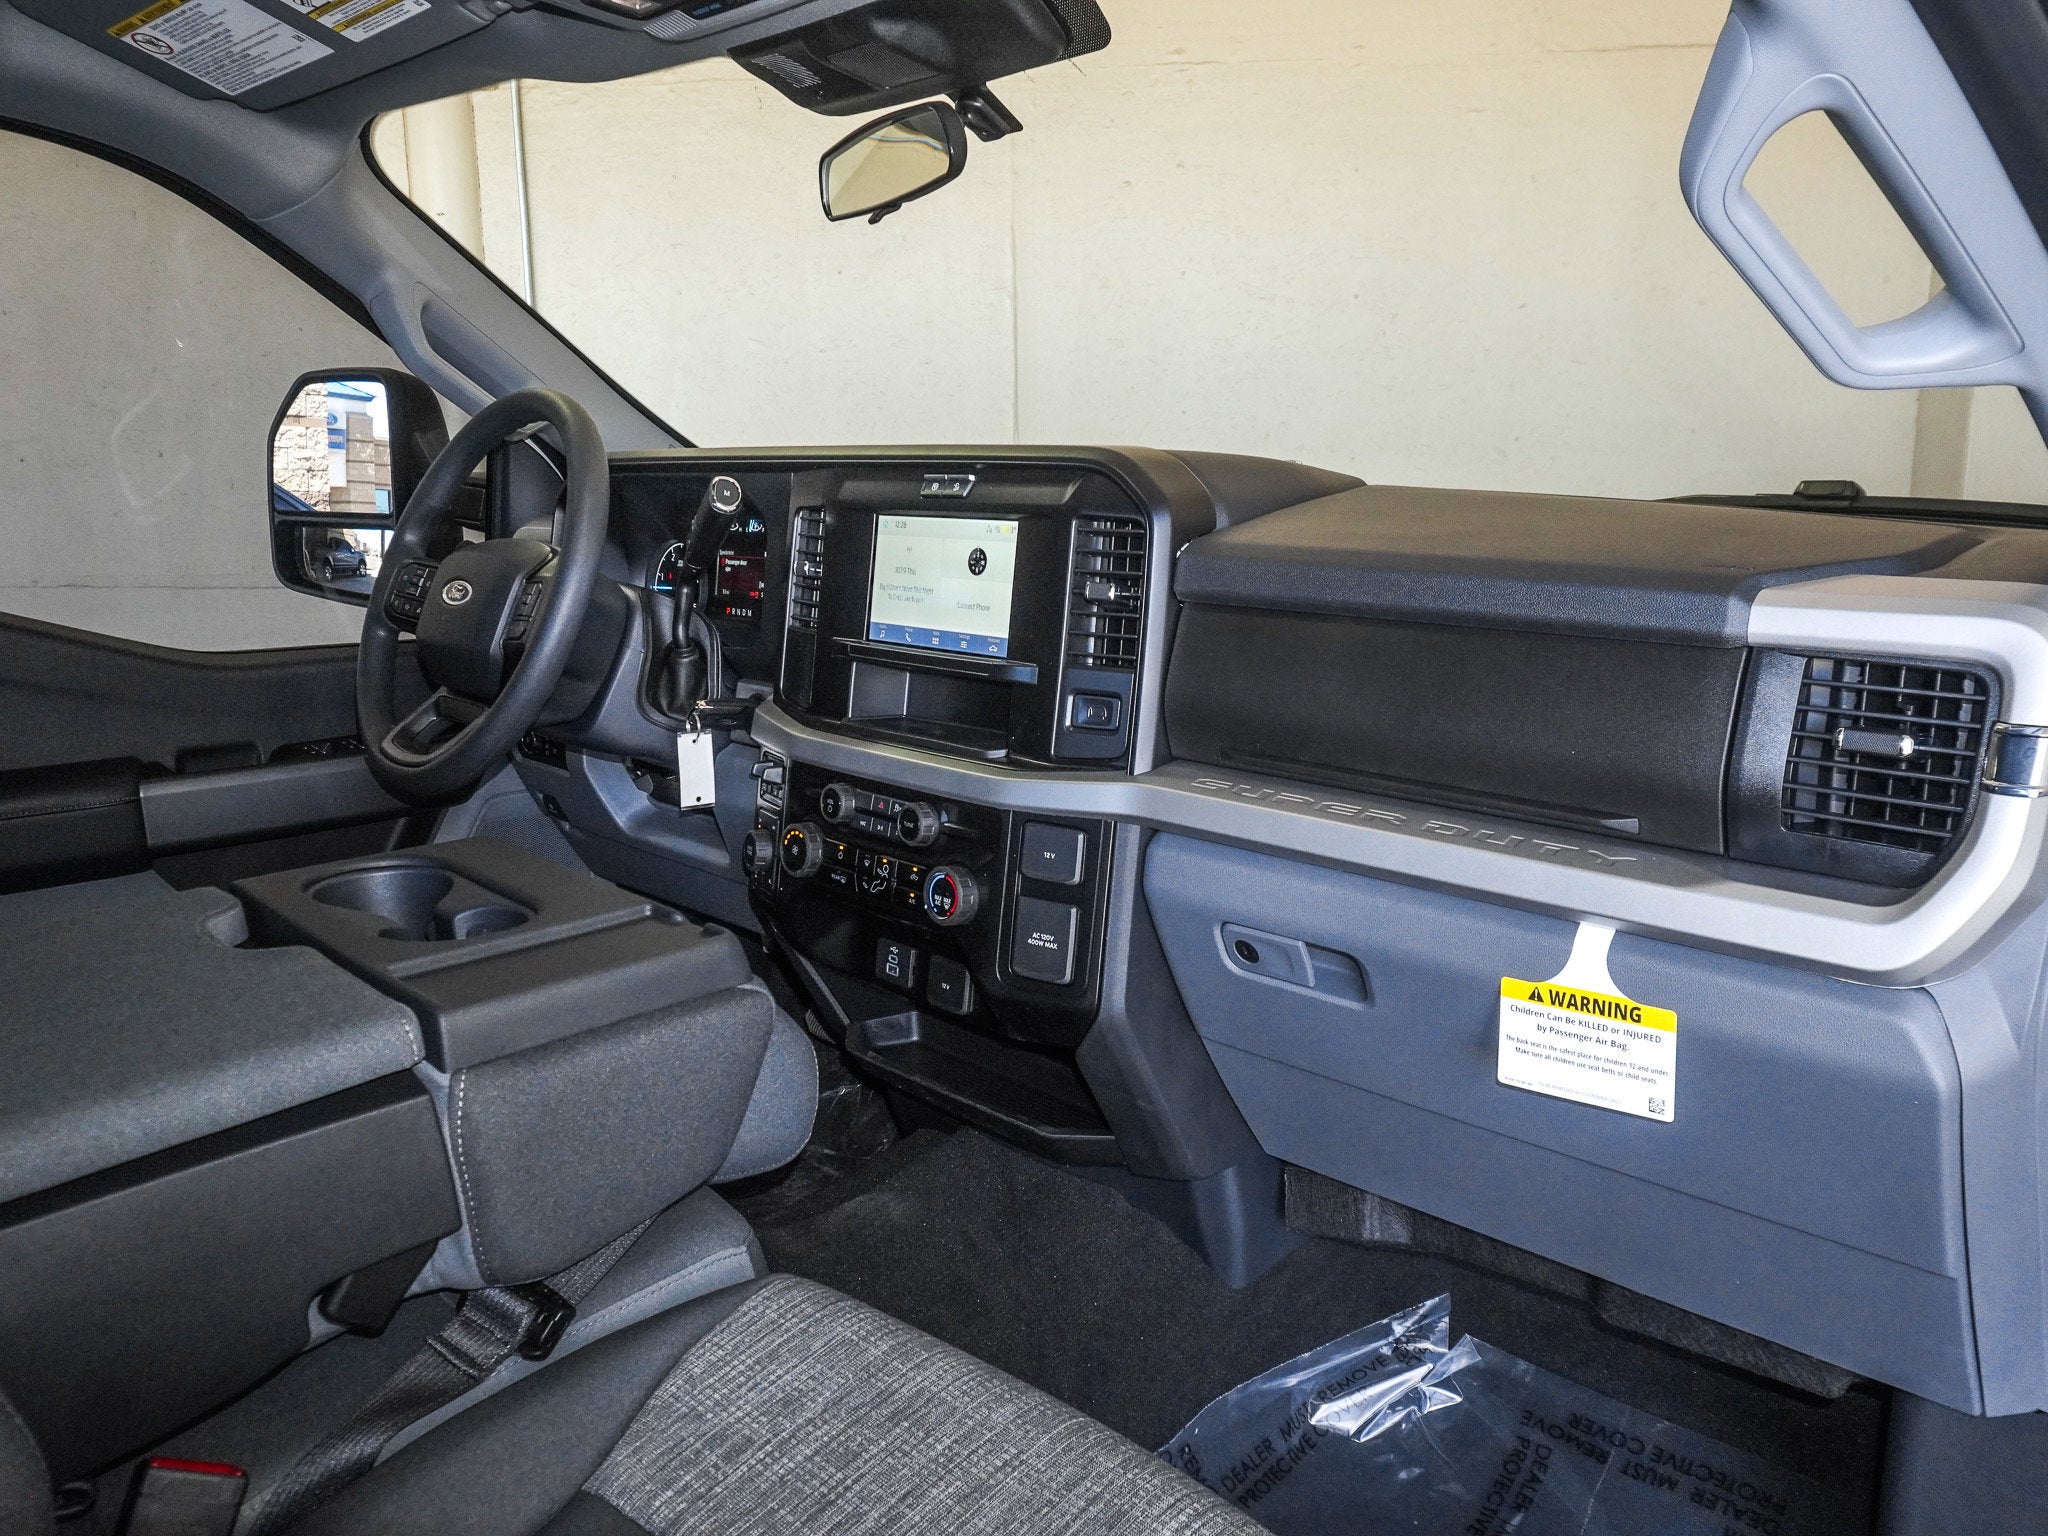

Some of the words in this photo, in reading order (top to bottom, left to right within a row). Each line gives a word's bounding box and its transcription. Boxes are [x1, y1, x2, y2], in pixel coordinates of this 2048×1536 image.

[1190, 778, 1407, 825] SUPER
[1420, 820, 1638, 867] DUTY
[1028, 938, 1044, 946] 400W
[1045, 941, 1058, 949] MAX
[1510, 1004, 1545, 1018] Children
[1547, 1013, 1563, 1022] Can
[1565, 1016, 1576, 1025] Be
[1579, 1020, 1608, 1032] KILLED
[1623, 1029, 1661, 1043] INJURED
[1548, 988, 1642, 1024] WARNING
[1506, 1034, 1515, 1043] The
[1517, 1037, 1528, 1045] back
[1530, 1041, 1541, 1049] seat
[1549, 1044, 1557, 1052] the
[1560, 1048, 1576, 1056] safest
[1577, 1051, 1592, 1060] place
[1604, 1057, 1627, 1067] children
[1630, 1062, 1635, 1070] 12
[1537, 1024, 1547, 1034] by
[1550, 1026, 1592, 1042] Passenger
[1595, 1037, 1608, 1046] Air
[1611, 1040, 1629, 1052] Bag.
[1515, 1046, 1530, 1056] Make
[1553, 1055, 1576, 1066] children
[1588, 1064, 1600, 1072] seat
[1601, 1067, 1616, 1075] belts
[1625, 1072, 1639, 1080] child
[1220, 1437, 1276, 1494] DEALER
[1316, 1354, 1391, 1401] REMOVE
[1520, 1409, 1611, 1465] REMOVE
[1568, 1413, 1645, 1455] COVER
[1236, 1432, 1318, 1509] PROTECTIVE
[1509, 1443, 1552, 1511] DEALER
[1619, 1459, 1680, 1492] MUST
[1650, 1445, 1788, 1516] PROTECTIVE
[1689, 1486, 1781, 1536] DEALER
